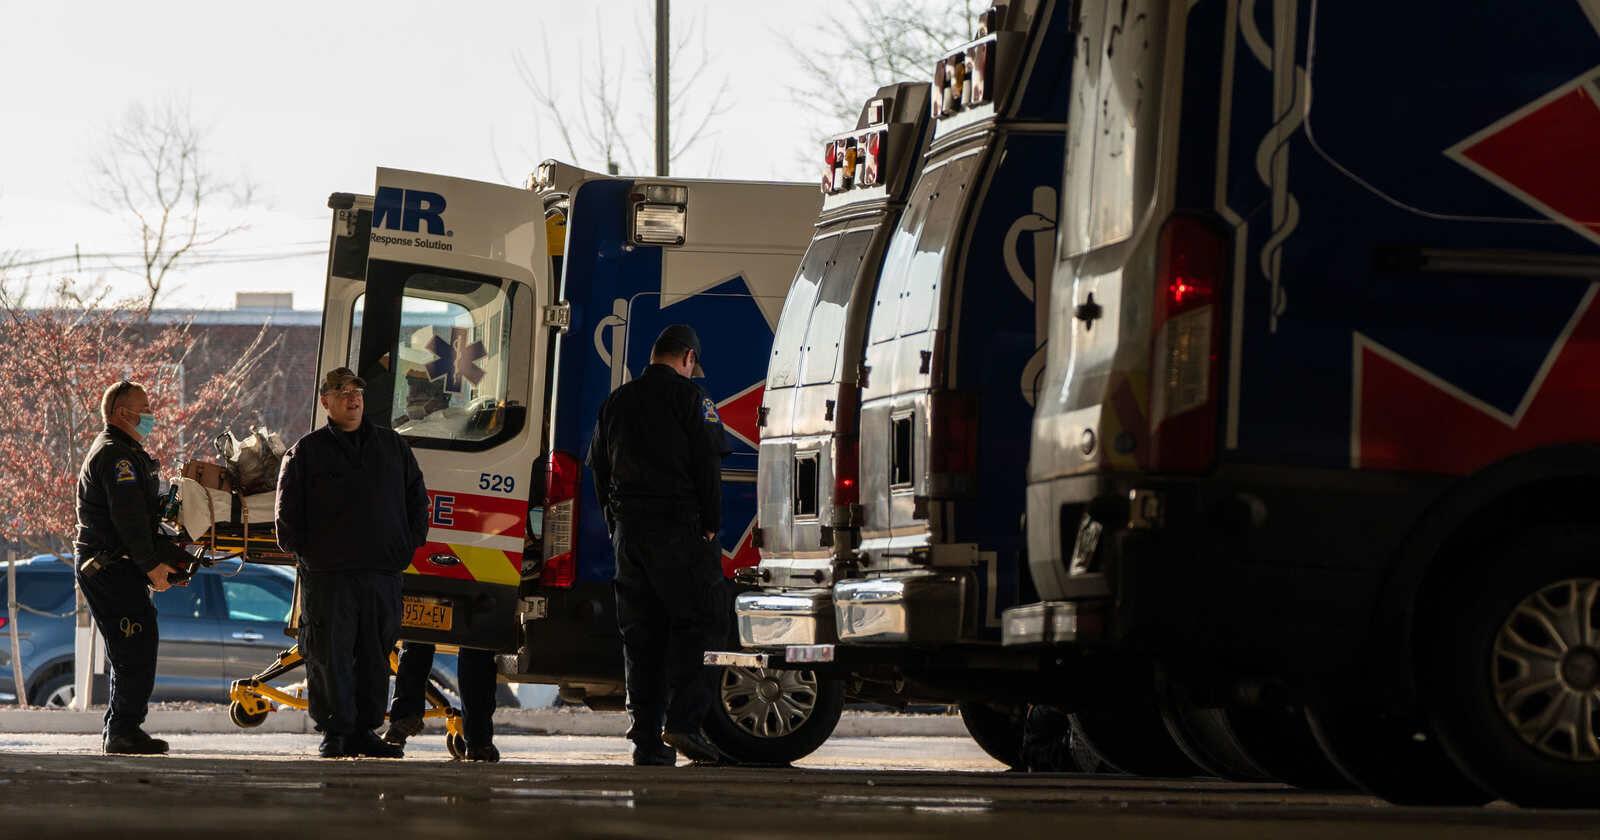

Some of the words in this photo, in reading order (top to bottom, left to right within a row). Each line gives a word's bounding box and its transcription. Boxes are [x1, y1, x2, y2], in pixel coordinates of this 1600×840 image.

[370, 232, 413, 247] Response
[414, 238, 453, 251] Solution
[479, 472, 515, 493] 529
[425, 494, 455, 526] E
